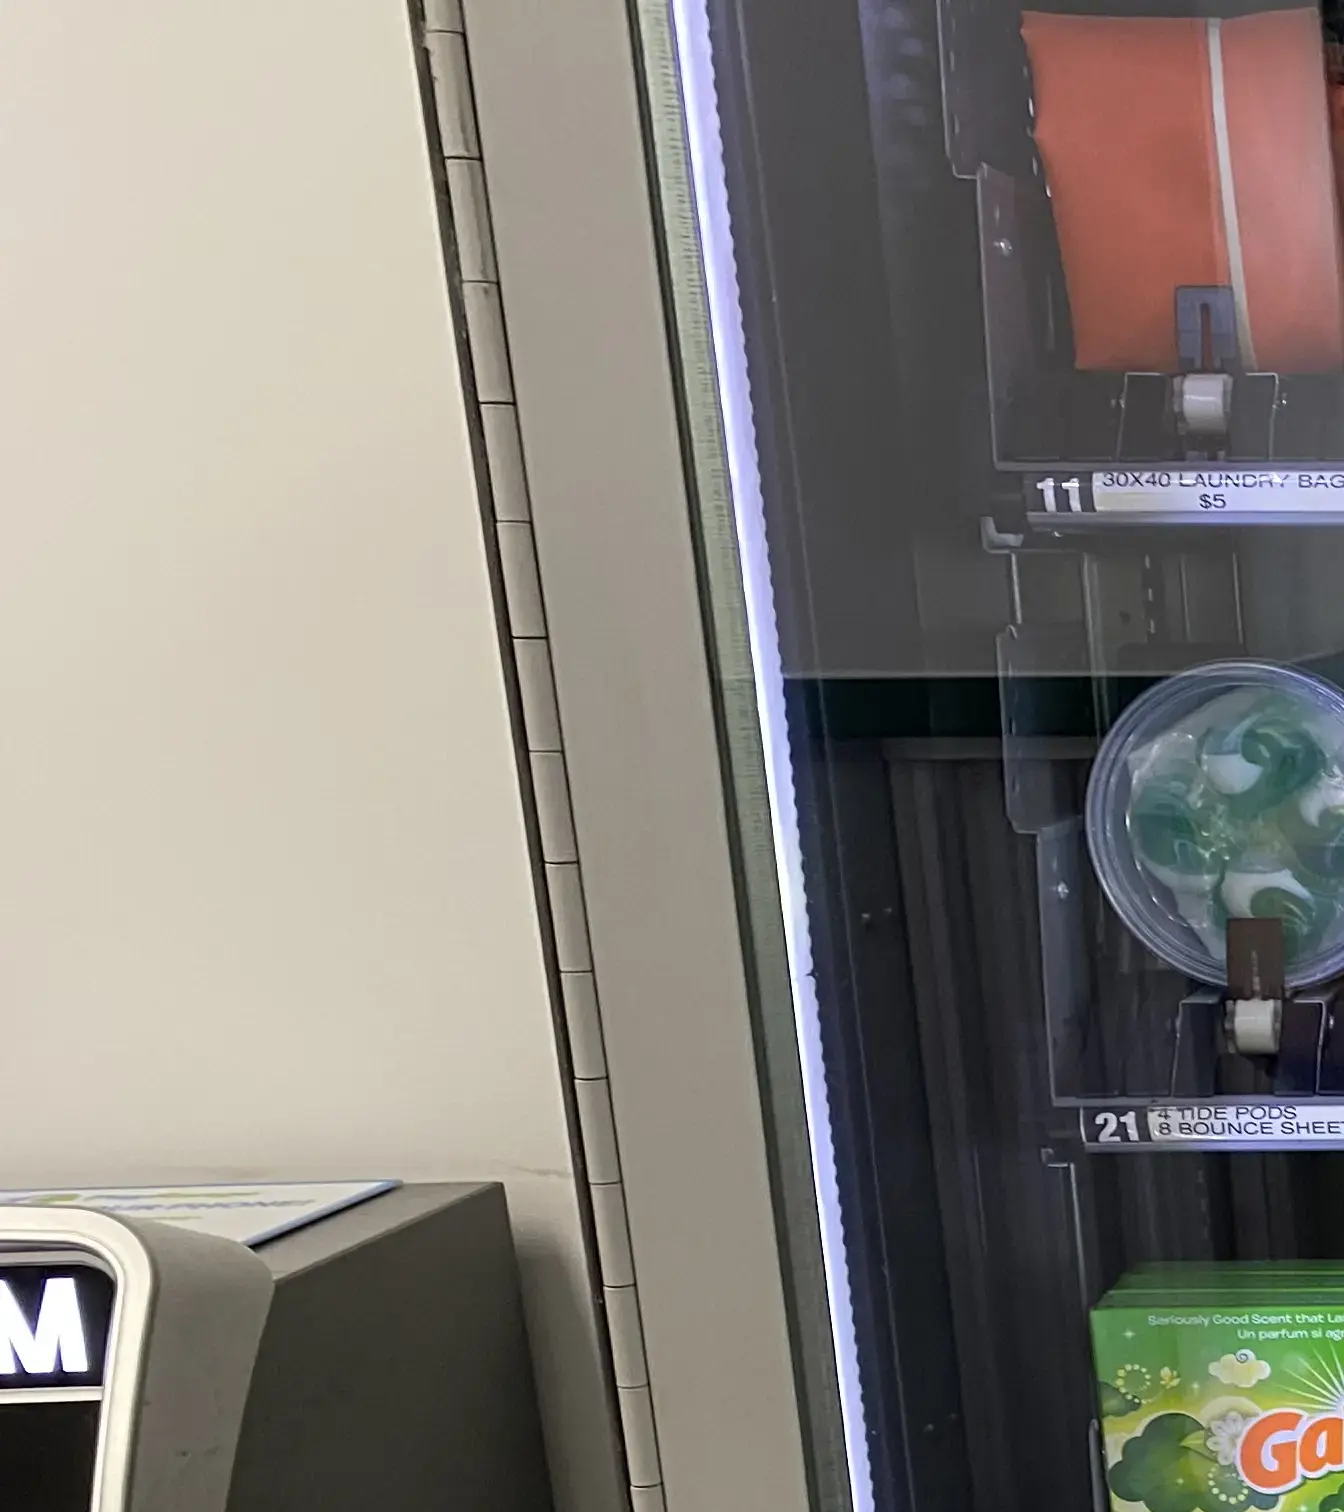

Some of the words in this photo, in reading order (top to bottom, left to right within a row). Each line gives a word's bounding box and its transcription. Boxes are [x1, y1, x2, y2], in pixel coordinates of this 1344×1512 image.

[1037, 477, 1080, 512] 11
[1103, 473, 1171, 487] 30X40
[1200, 493, 1226, 509] $5
[1178, 1107, 1228, 1120] TIDE
[1236, 1106, 1297, 1120] PODS
[1095, 1111, 1139, 1142] 21
[1158, 1121, 1172, 1135] 8
[1178, 1121, 1272, 1135] BOUNCE
[1148, 1314, 1210, 1327] Seriously
[1212, 1314, 1249, 1325] Good
[1252, 1313, 1293, 1324] Scent
[1295, 1313, 1324, 1324] that
[1237, 1329, 1256, 1340] Un
[1259, 1328, 1309, 1341] parfum
[1311, 1328, 1323, 1339] si
